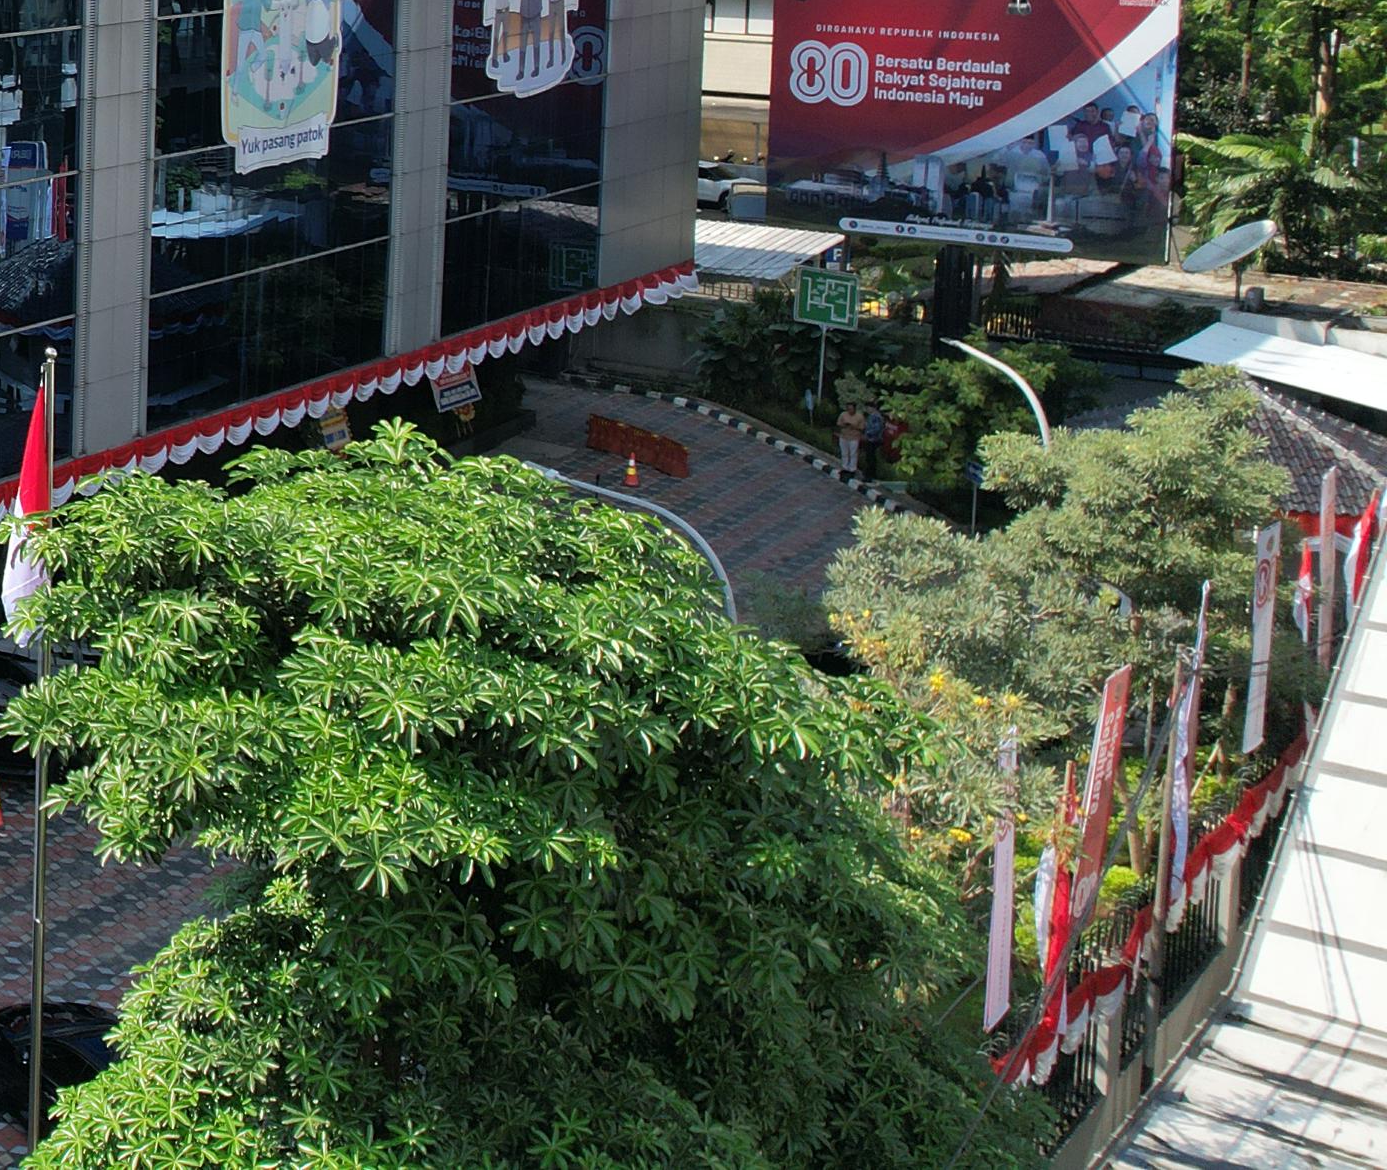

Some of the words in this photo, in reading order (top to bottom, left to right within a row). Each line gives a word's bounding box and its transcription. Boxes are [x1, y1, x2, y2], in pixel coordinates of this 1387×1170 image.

[816, 24, 876, 35] DIRGAHAYU
[880, 27, 934, 38] REPUBLIK
[938, 30, 1001, 42] INDONESIA
[789, 39, 869, 107] 80
[875, 53, 933, 71] Bersatu
[935, 57, 1011, 75] Berdaulat
[874, 70, 925, 87] Rakyat
[928, 73, 1002, 92] Sejahtera
[874, 87, 945, 105] Indonesia
[948, 92, 984, 110] Maju
[240, 137, 261, 155] Yuk
[262, 133, 296, 153] pasang
[296, 126, 324, 146] patok
